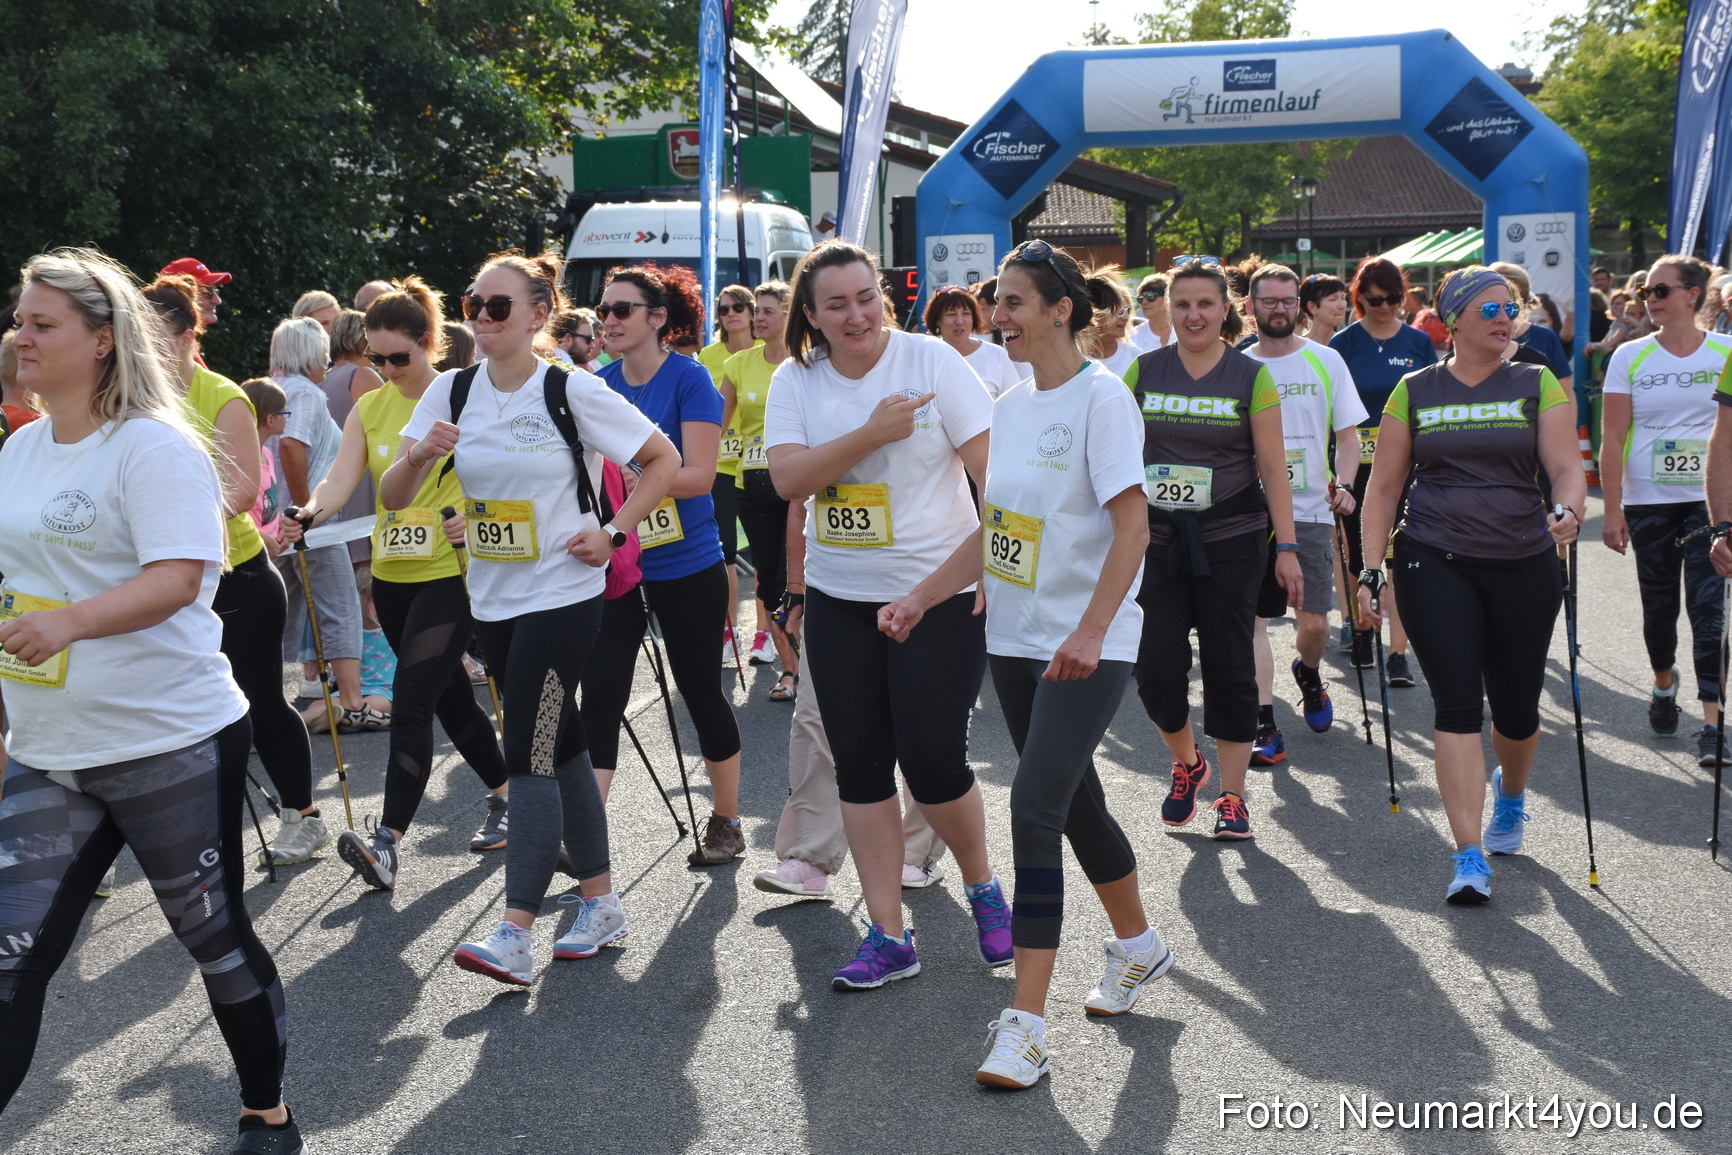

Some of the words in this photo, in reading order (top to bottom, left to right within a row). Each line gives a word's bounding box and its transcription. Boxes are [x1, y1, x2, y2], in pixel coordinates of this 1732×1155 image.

[1233, 71, 1273, 82] Fischer
[1204, 88, 1322, 115] firmenlauf
[1204, 114, 1252, 123] neumarkt
[985, 141, 1046, 155] Fischer
[990, 153, 1040, 161] AUTOMOBILE
[583, 231, 631, 243] abavent
[1388, 356, 1405, 366] vhs
[1641, 369, 1722, 390] gangar
[1143, 394, 1236, 416] BOCK
[1168, 415, 1178, 423] by
[1206, 418, 1241, 427] concepts
[1418, 401, 1523, 426] BOCK
[1450, 422, 1460, 431] by
[1463, 421, 1490, 429] smart
[724, 440, 743, 452] 12
[1664, 455, 1701, 472] 923
[1156, 483, 1195, 503] 292
[43, 513, 87, 532] NATURKOST
[827, 506, 871, 531] 683
[382, 526, 427, 548] 1239
[477, 521, 515, 545] 691
[844, 530, 877, 538] Josephine
[67, 537, 97, 552] Nuss!
[991, 532, 1022, 565] 692
[28, 668, 47, 678] GmbH
[202, 890, 212, 917] Reebok
